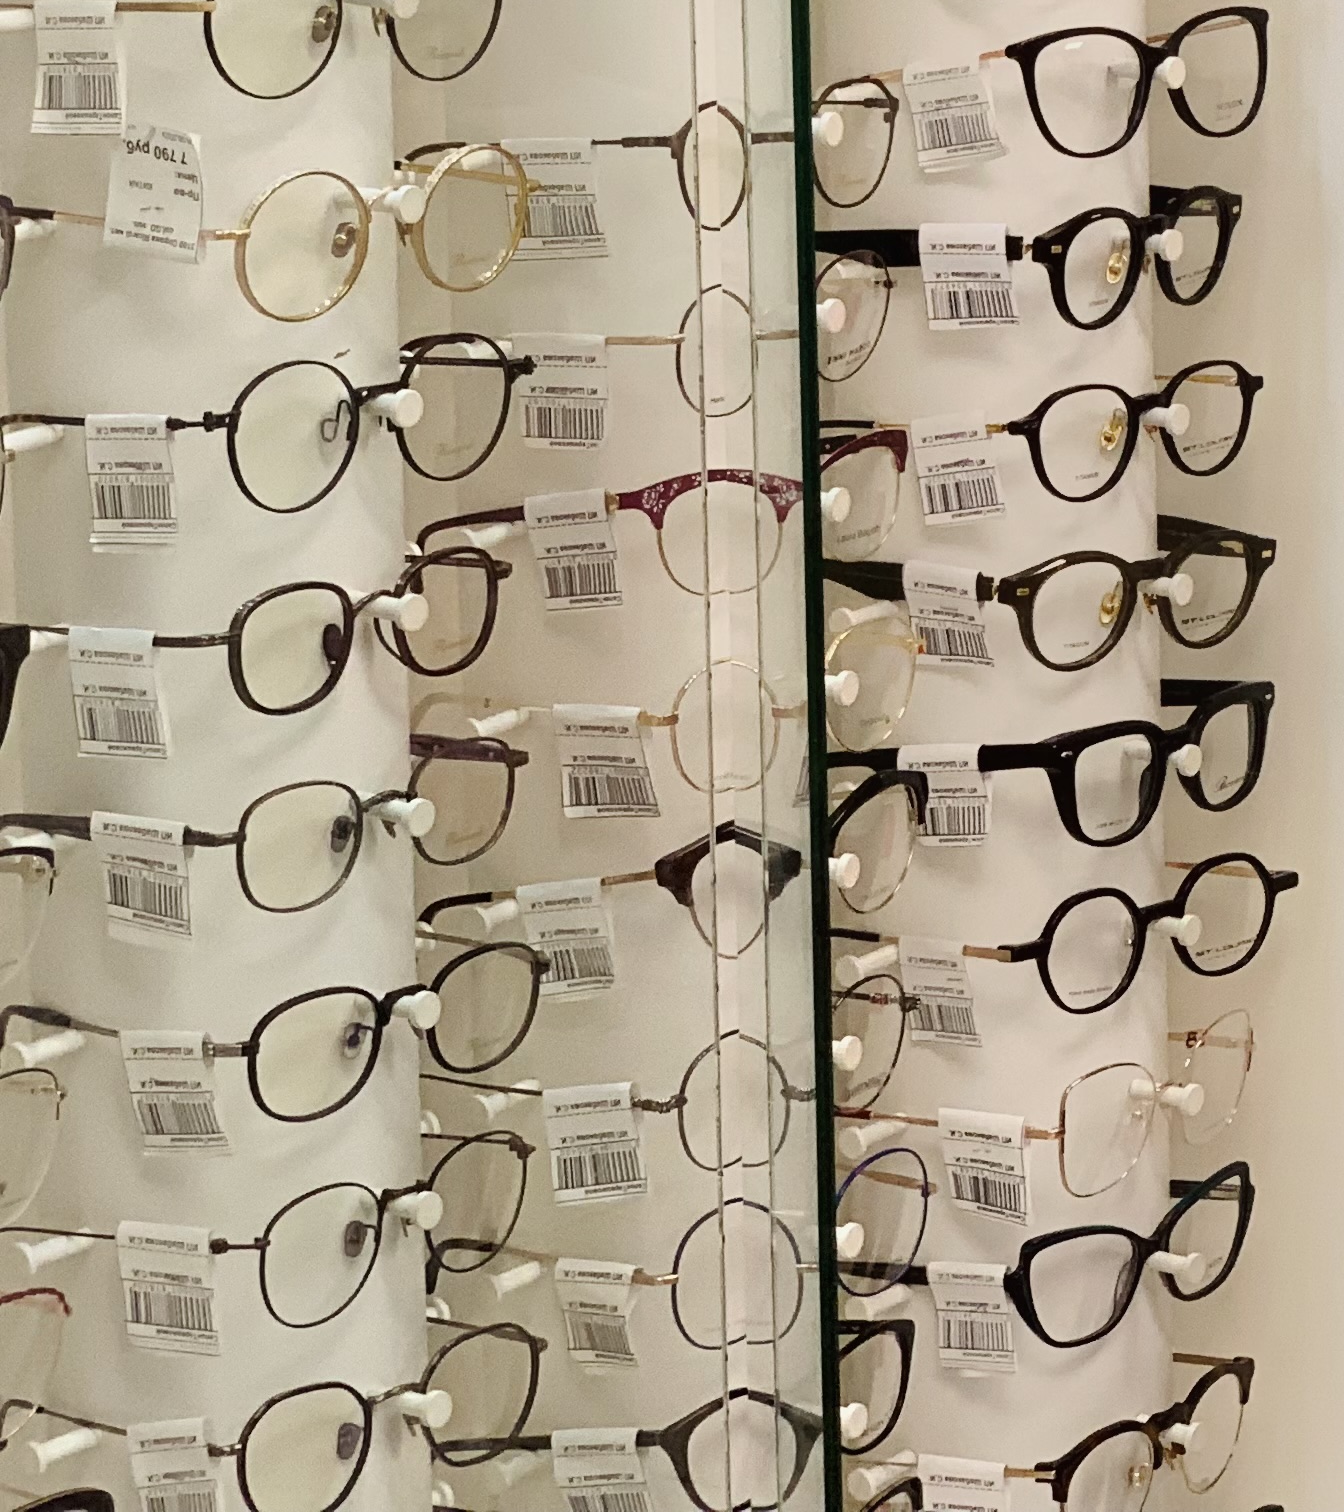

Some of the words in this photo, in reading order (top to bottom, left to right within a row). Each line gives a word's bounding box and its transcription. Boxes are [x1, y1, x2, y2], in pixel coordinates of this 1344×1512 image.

[122, 139, 150, 154] руб.
[153, 146, 176, 163] 790
[180, 152, 188, 165] 7
